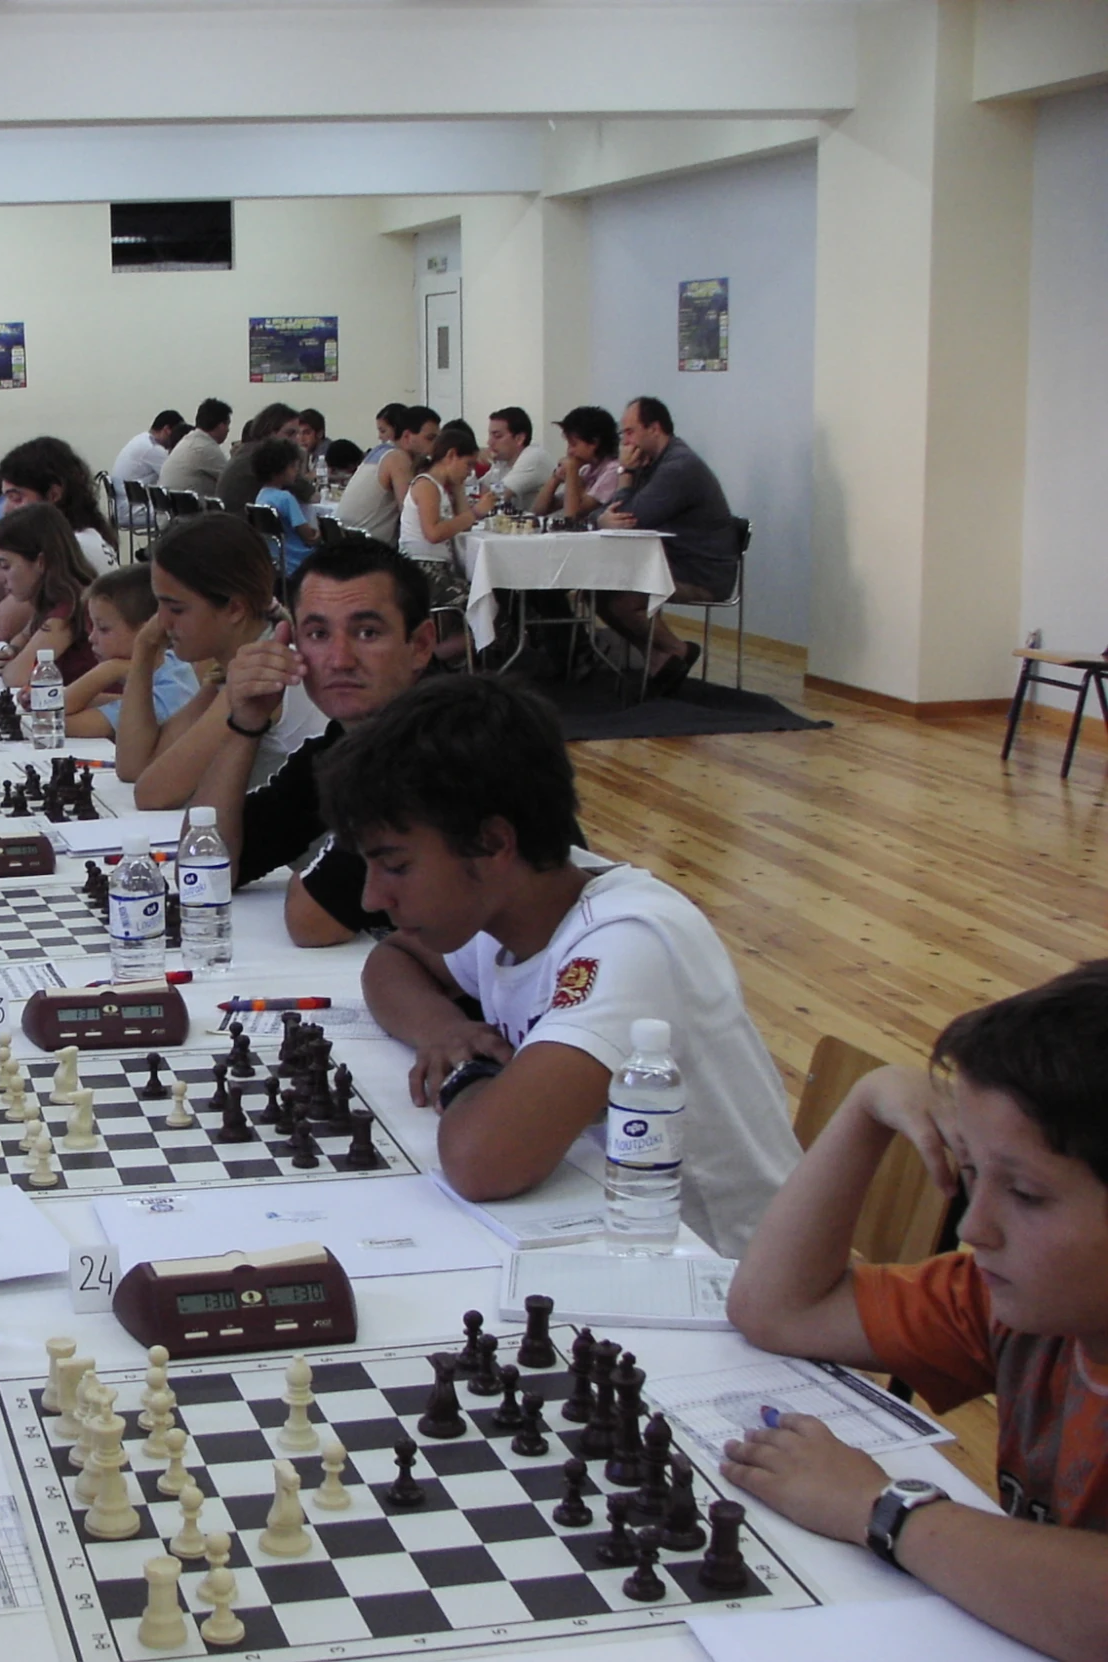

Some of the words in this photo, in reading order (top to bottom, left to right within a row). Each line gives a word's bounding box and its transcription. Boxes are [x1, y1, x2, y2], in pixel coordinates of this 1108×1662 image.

[79, 1254, 114, 1296] 24
[204, 1293, 233, 1309] 1:30
[292, 1283, 322, 1301] 1:30
[330, 1645, 345, 1654] 3
[572, 1618, 588, 1627] 6
[726, 1601, 742, 1610] 8
